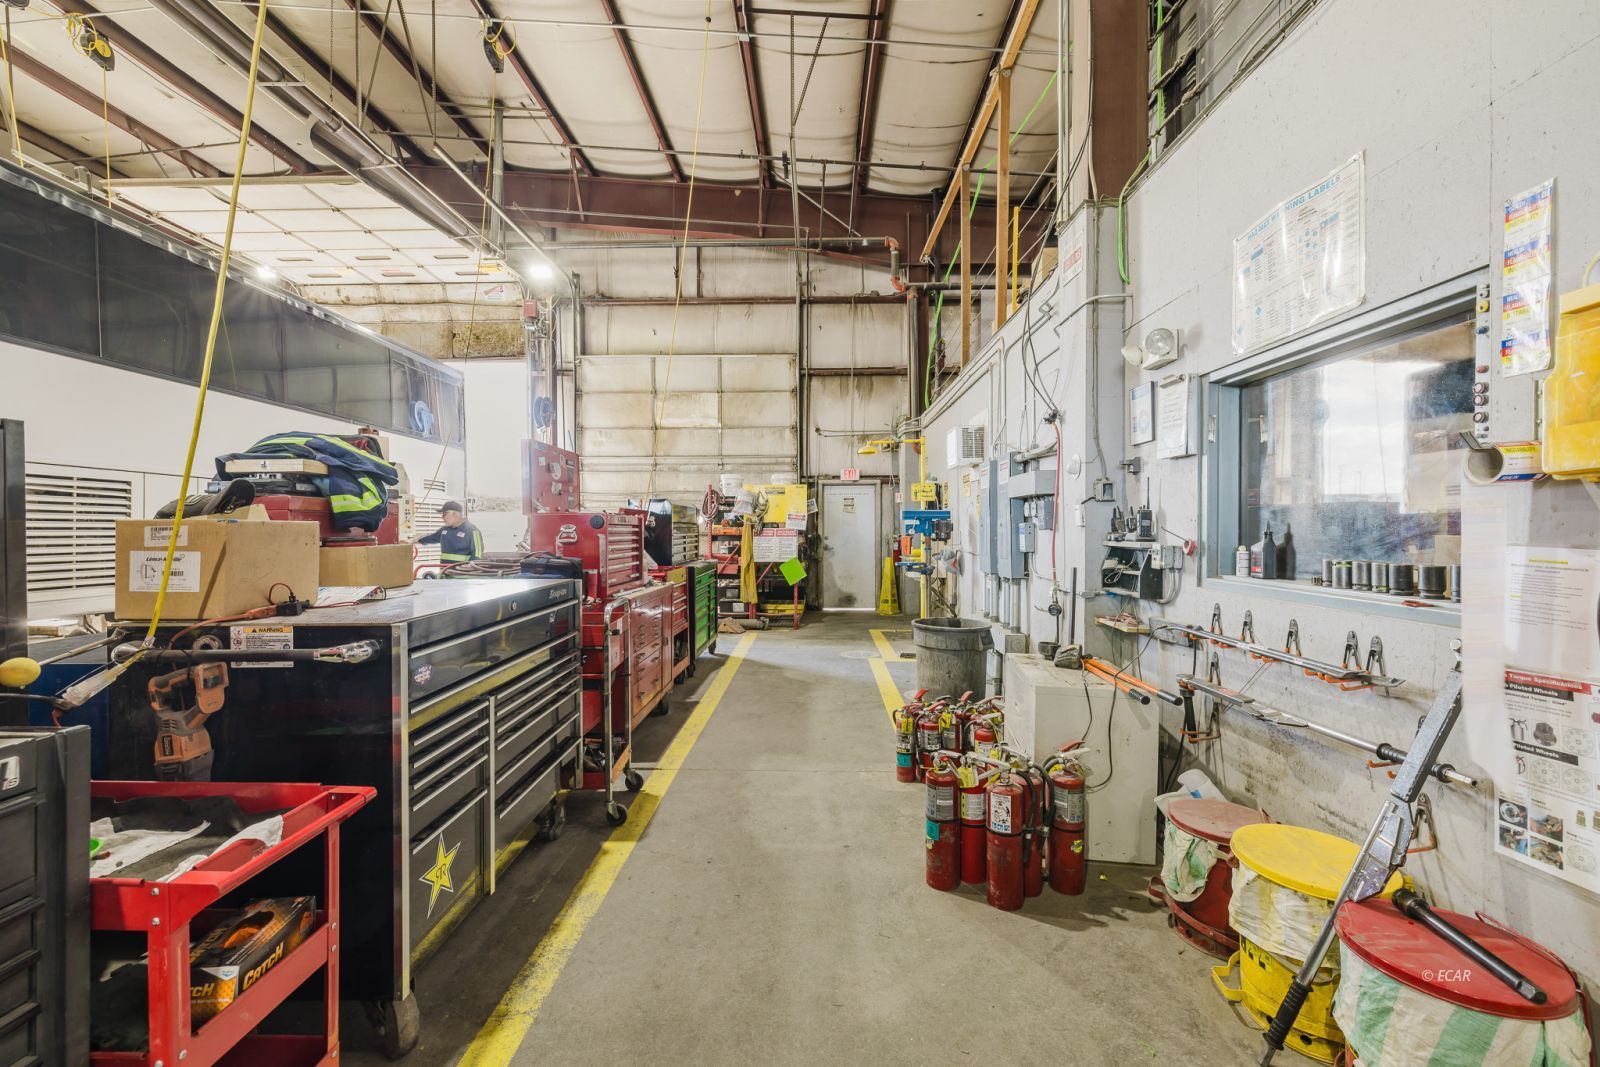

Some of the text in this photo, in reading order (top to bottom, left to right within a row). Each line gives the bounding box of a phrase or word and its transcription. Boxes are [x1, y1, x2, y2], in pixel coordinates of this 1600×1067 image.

[1308, 174, 1341, 200] LABELS
[843, 468, 857, 480] EXIT
[1509, 673, 1532, 682] Torque
[1534, 677, 1583, 690] Specifications
[1509, 683, 1558, 697] Piloted Wheels
[1535, 748, 1560, 759] Wheels
[243, 941, 284, 991] CATCH
